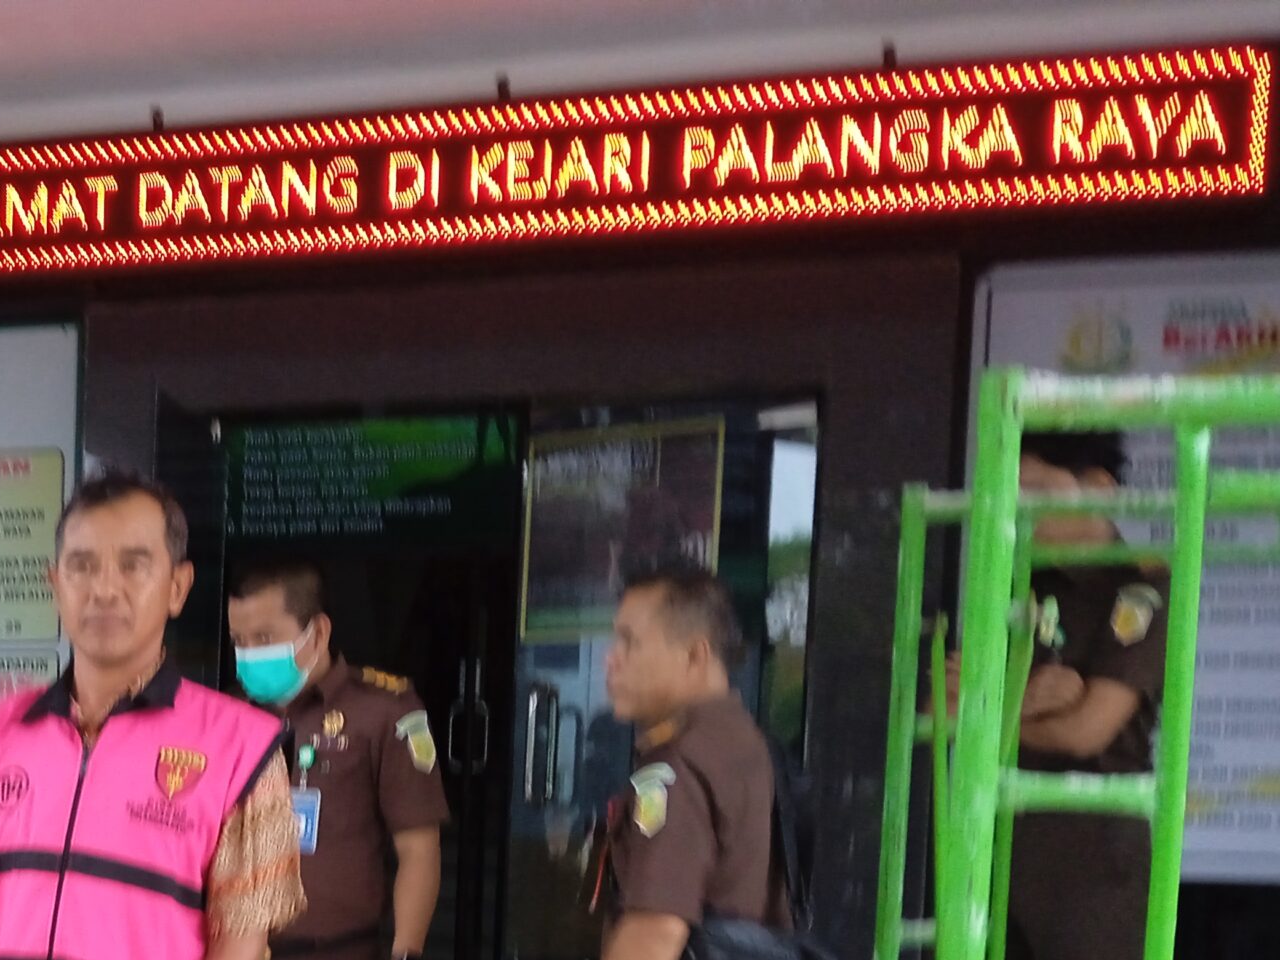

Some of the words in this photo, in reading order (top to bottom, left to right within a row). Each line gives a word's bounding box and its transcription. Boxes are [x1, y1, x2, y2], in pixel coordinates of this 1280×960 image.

[137, 155, 359, 229] DATANG
[388, 147, 440, 209] DI
[470, 130, 649, 204] KEJARI
[681, 104, 1023, 189] PALANGKA
[1051, 90, 1226, 163] RAYA
